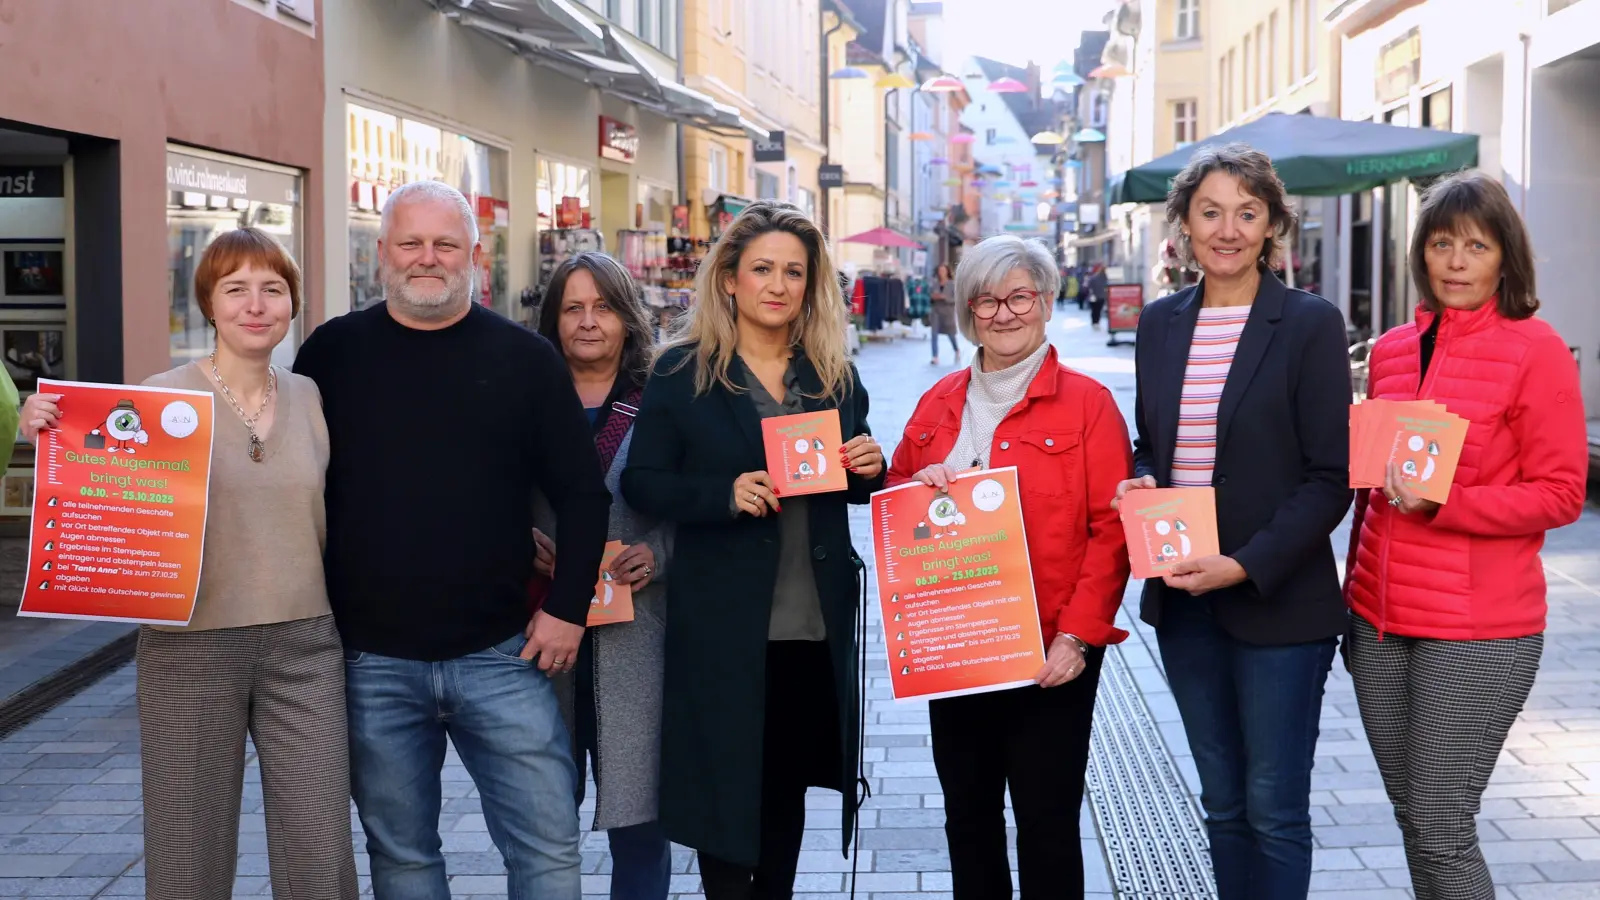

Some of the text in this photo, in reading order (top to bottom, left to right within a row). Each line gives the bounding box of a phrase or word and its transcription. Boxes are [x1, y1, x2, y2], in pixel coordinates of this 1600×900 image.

[65, 450, 190, 471] Gutes Augenmaß
[90, 472, 168, 488] bringt was!
[80, 486, 108, 498] 06.10.
[122, 490, 174, 504] 25.10.2025
[61, 511, 102, 520] aufsuchen
[78, 502, 135, 513] teilnehmenden
[136, 507, 174, 517] Geschäfte
[60, 532, 126, 544] Augen abmessen
[74, 522, 87, 530] Ort
[88, 524, 135, 534] betreffendes
[136, 528, 161, 538] Objekt
[175, 531, 190, 539] den
[59, 542, 101, 552] Ergebnisse
[112, 546, 161, 557] Stempelpass
[899, 529, 1008, 558] Gutes Augenmaß
[58, 552, 95, 563] eintragen
[112, 557, 157, 568] abstempeln
[158, 561, 181, 569] lassen
[922, 551, 991, 571] bringt was!
[55, 574, 90, 583] abgeben
[57, 562, 70, 570] bei
[71, 563, 96, 573] "Tante
[96, 566, 122, 575] Anna"
[151, 570, 178, 579] 27.10.25
[915, 575, 941, 586] 06.10.
[952, 565, 999, 580] 25.10.2025
[68, 584, 90, 593] Glück
[108, 588, 149, 597] Gutscheine
[150, 591, 186, 600] gewinnen
[916, 585, 966, 598] teilnehmenden
[967, 580, 1002, 590] Geschäfte
[905, 600, 940, 609] aufsuchen
[929, 603, 972, 615] betreffendes
[972, 599, 994, 608] Objekt
[1007, 595, 1021, 603] den
[908, 614, 965, 628] Augen abmessen
[909, 625, 945, 637] Ergebnisse
[955, 618, 999, 630] Stempelpass
[910, 634, 942, 645] eintragen
[957, 627, 998, 639] abstempeln
[999, 623, 1020, 632] lassen
[911, 647, 922, 655] bei
[913, 654, 943, 664] abgeben
[926, 662, 946, 671] Glück
[946, 660, 961, 668] tolle
[961, 655, 1000, 666] Gutscheine
[1000, 650, 1034, 662] gewinnen
